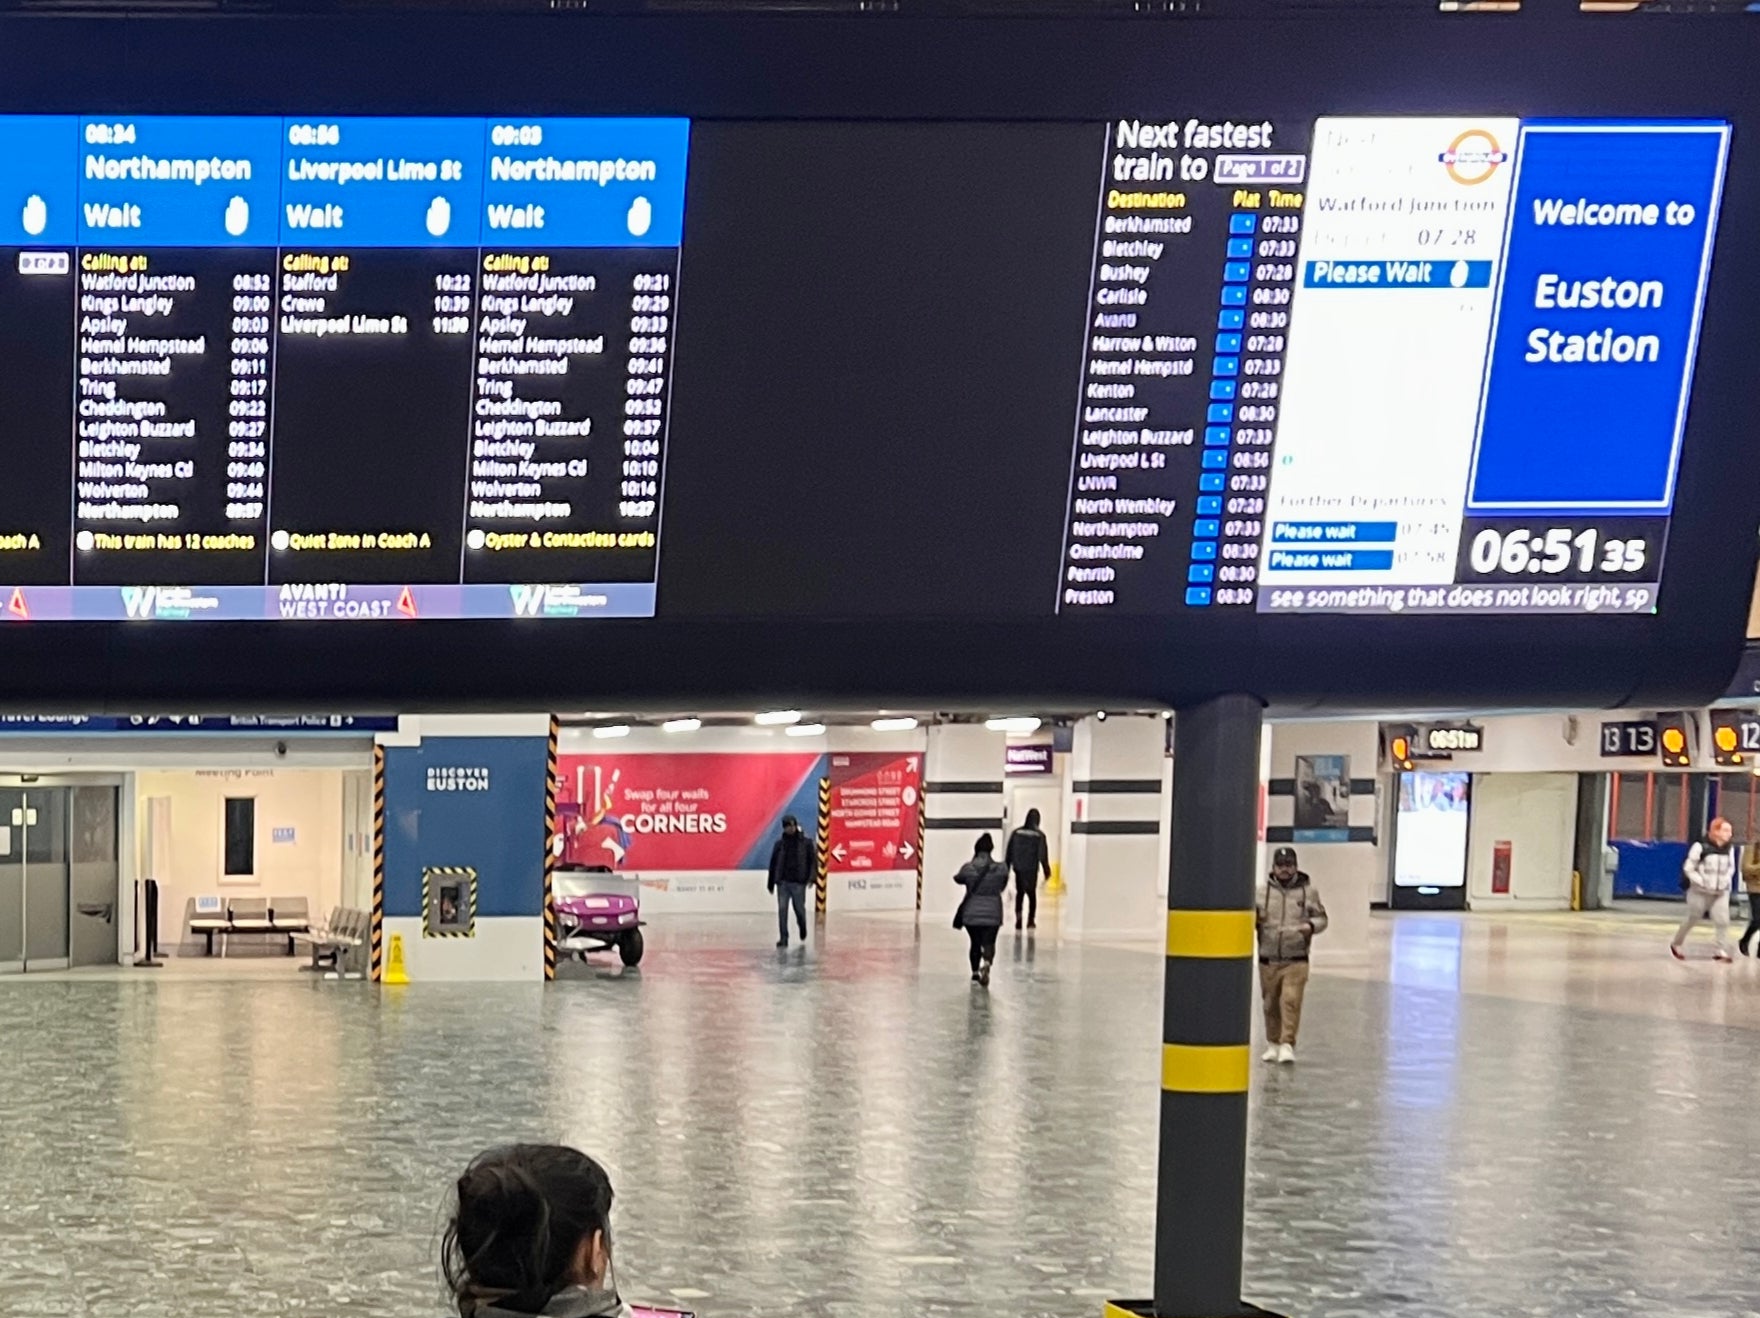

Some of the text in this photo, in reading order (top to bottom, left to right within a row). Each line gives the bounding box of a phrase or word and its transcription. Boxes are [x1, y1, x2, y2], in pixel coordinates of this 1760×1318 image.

[1116, 118, 1273, 149] Next fastest
[85, 154, 252, 186] Northampton
[288, 158, 463, 185] Liverpool Lime St
[491, 156, 657, 187] Northampton
[1113, 151, 1208, 181] train to
[1107, 189, 1186, 209] Destination
[1232, 189, 1261, 208] Plat
[1268, 189, 1303, 208] Time
[83, 202, 141, 228] Wait
[285, 203, 344, 229] Wait
[487, 203, 545, 229] Wait
[1533, 198, 1695, 226] Welcome to
[81, 253, 129, 274] Calling
[129, 255, 148, 271] at:
[282, 253, 349, 274] Calling at:
[483, 253, 550, 274] Calling at:
[1313, 261, 1433, 283] Please Wait
[282, 274, 338, 292] Stafford
[1535, 274, 1663, 308] Euston
[281, 294, 326, 313] Crewe
[280, 314, 408, 338] Liverpool Lime St
[1525, 327, 1659, 363] Station
[28, 533, 41, 550] A
[92, 533, 256, 550] This train has 12 coaches
[287, 532, 432, 551] Quiet Zone in Coach A
[483, 531, 529, 551] Oyster
[542, 531, 617, 548] Contactless
[617, 530, 655, 548] cards
[1275, 523, 1356, 540] Please wait
[1271, 552, 1351, 568] Please wait
[1470, 528, 1646, 575] 06:51 35
[279, 583, 347, 601] AVANTI
[1270, 586, 1649, 612] see something that does not look right, sp
[279, 600, 392, 618] WEST COAST
[1628, 727, 1653, 750] 13
[427, 767, 489, 778] DISCOVER
[427, 777, 489, 791] EUSTON
[621, 813, 727, 833] CORNERS
